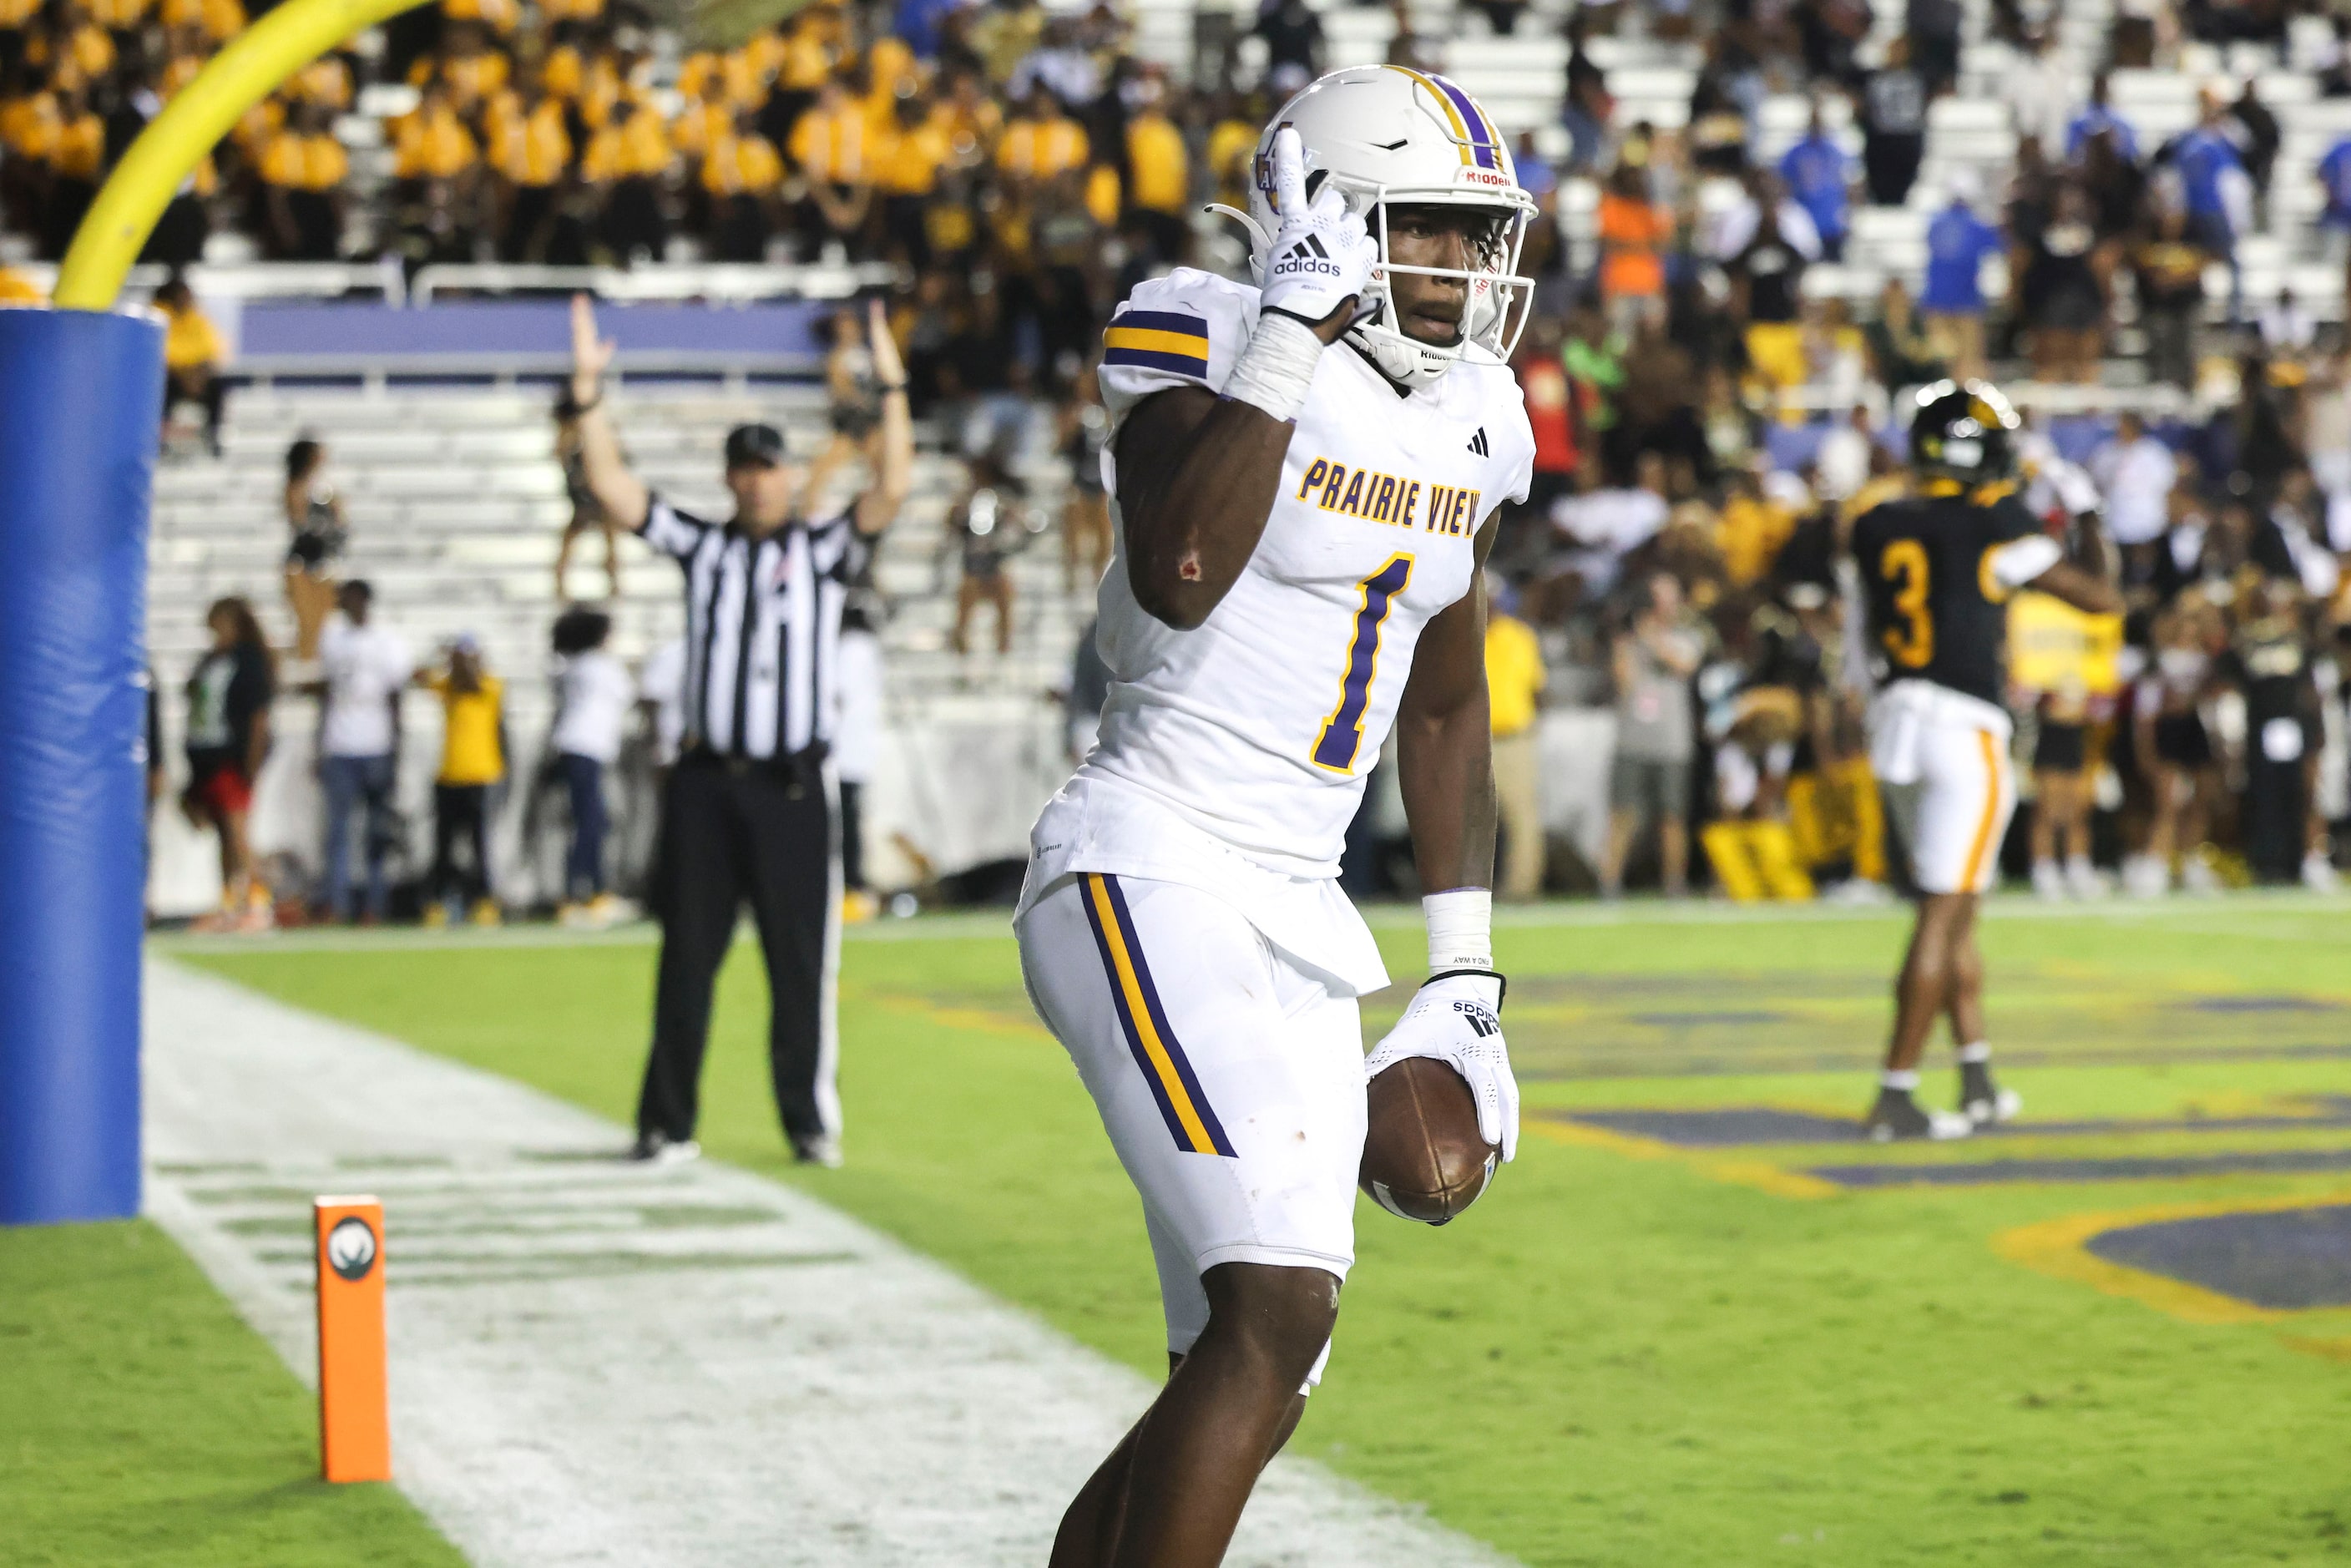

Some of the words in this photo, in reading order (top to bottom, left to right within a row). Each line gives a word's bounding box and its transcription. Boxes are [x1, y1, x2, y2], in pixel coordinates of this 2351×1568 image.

[1274, 258, 1341, 277] adidas
[1296, 456, 1421, 528] PRAIRIE
[1881, 539, 1934, 669] 3
[1309, 550, 1416, 776] 1
[1454, 1002, 1499, 1028] adidas
